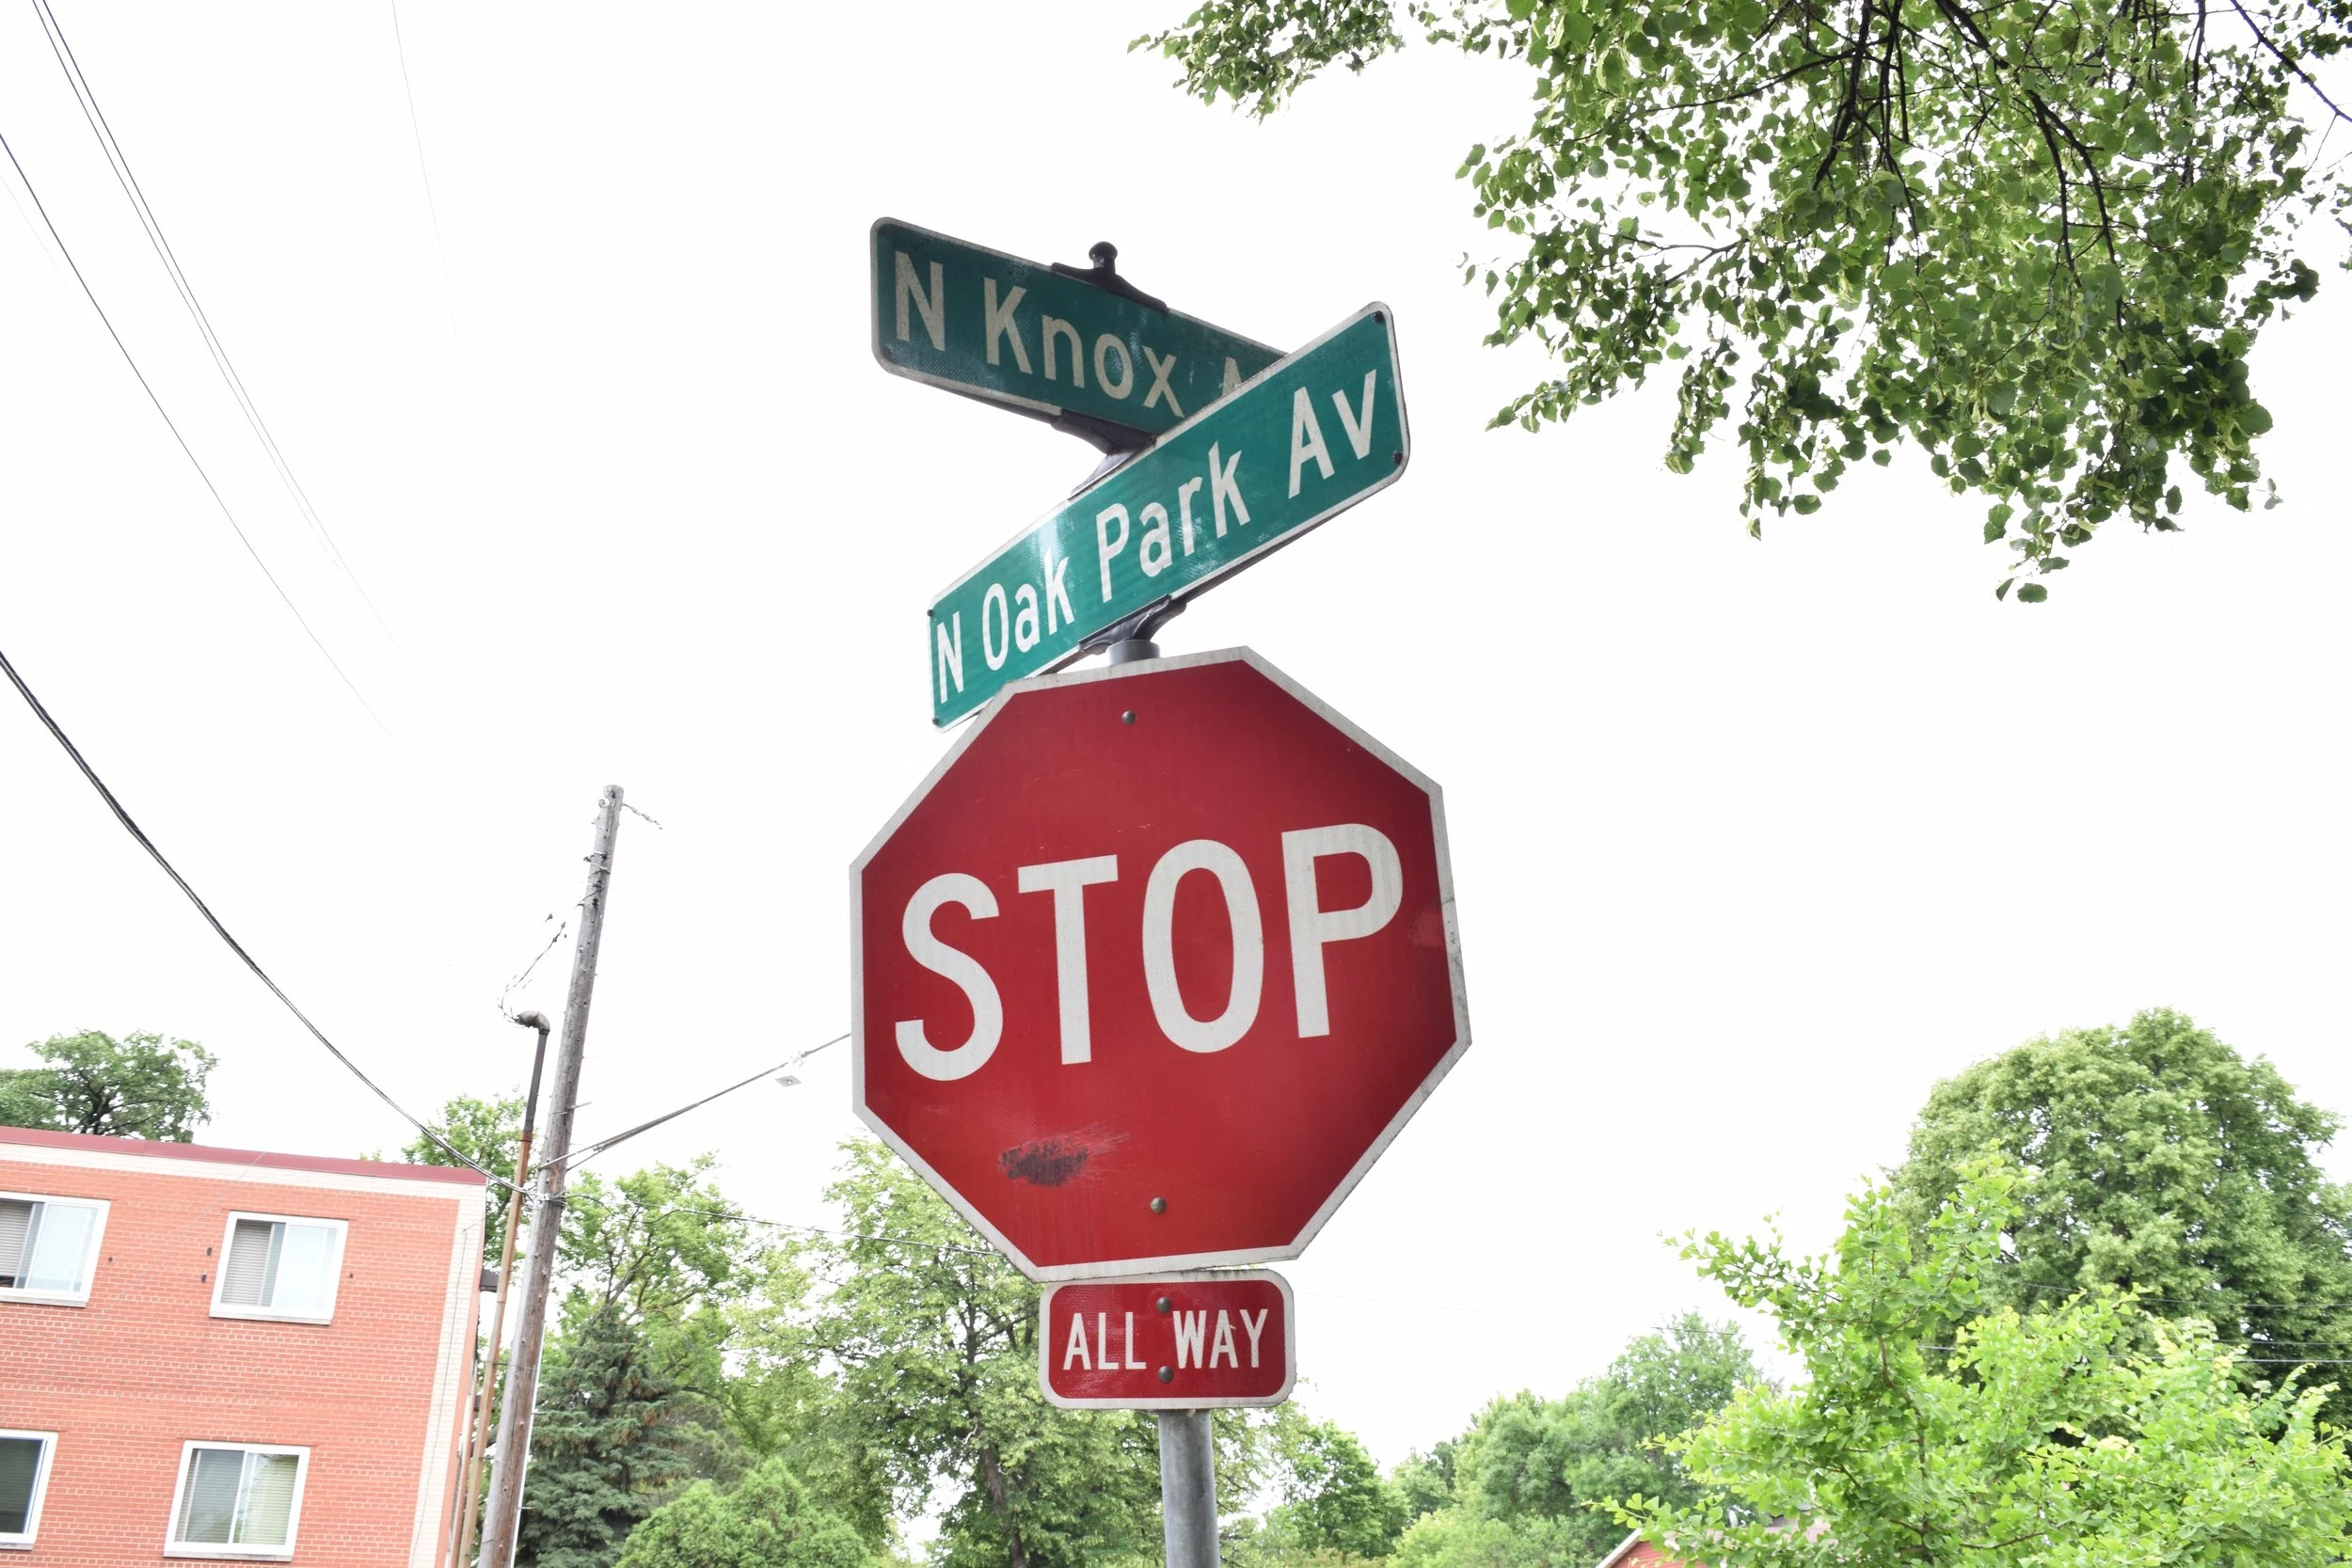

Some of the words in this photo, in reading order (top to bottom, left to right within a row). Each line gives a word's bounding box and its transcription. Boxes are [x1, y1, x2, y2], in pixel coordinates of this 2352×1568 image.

[895, 250, 945, 351] N
[983, 277, 1185, 419] Knox
[937, 611, 964, 704] N
[981, 548, 1074, 671] Oak
[1095, 441, 1251, 602] Park
[1288, 370, 1376, 499] Av
[895, 822, 1403, 1081] STOP
[1062, 1311, 1147, 1370] ALL
[1172, 1308, 1268, 1370] WAY
